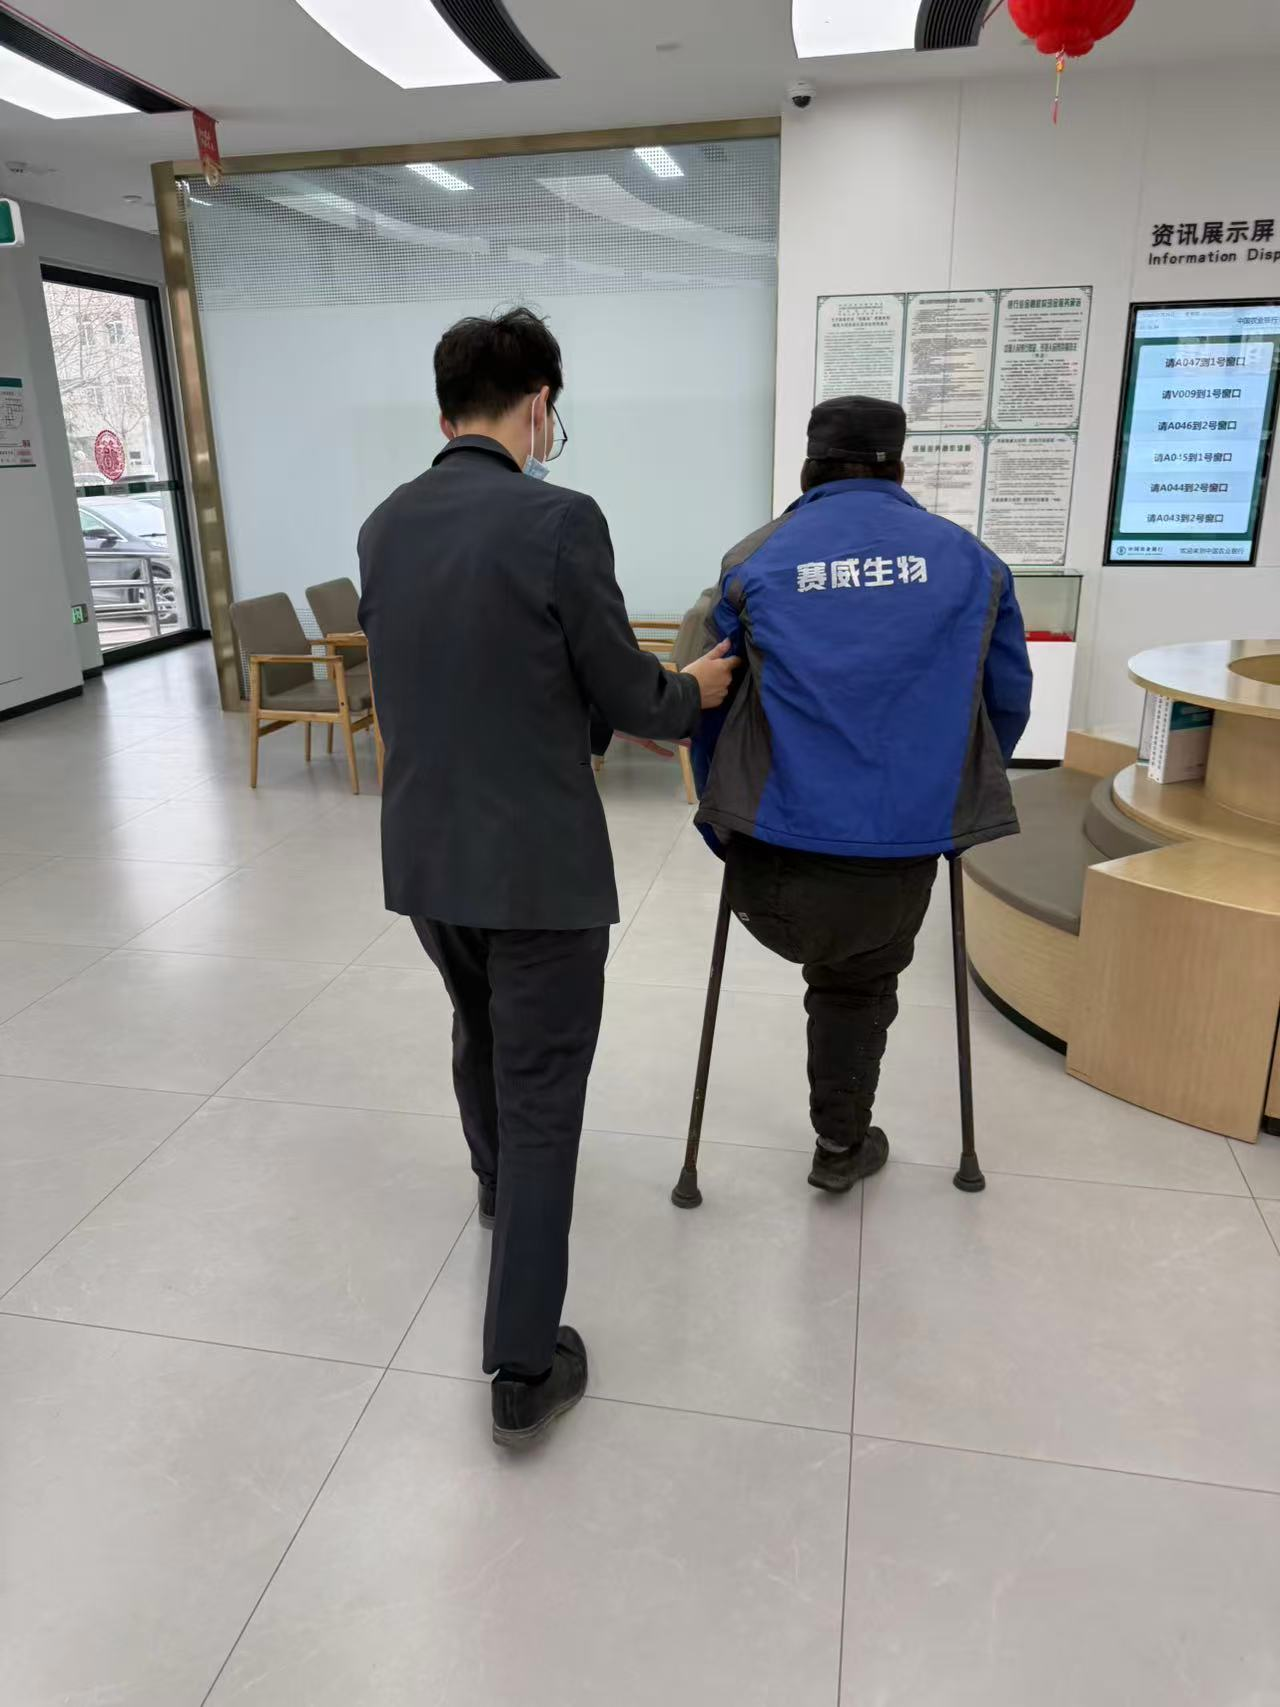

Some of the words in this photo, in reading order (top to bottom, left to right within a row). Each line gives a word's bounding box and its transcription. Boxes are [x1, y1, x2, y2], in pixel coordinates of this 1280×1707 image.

[1151, 219, 1275, 247] 资讯展示屏
[1148, 250, 1237, 265] Information
[1165, 356, 1246, 368] 请A047到1号窗口
[1161, 388, 1242, 400] 请V009到1号窗口
[1158, 420, 1237, 431] 请A046到2号窗口
[1150, 483, 1228, 493] 请A044到2号窗口
[797, 555, 928, 593] 赛威生物
